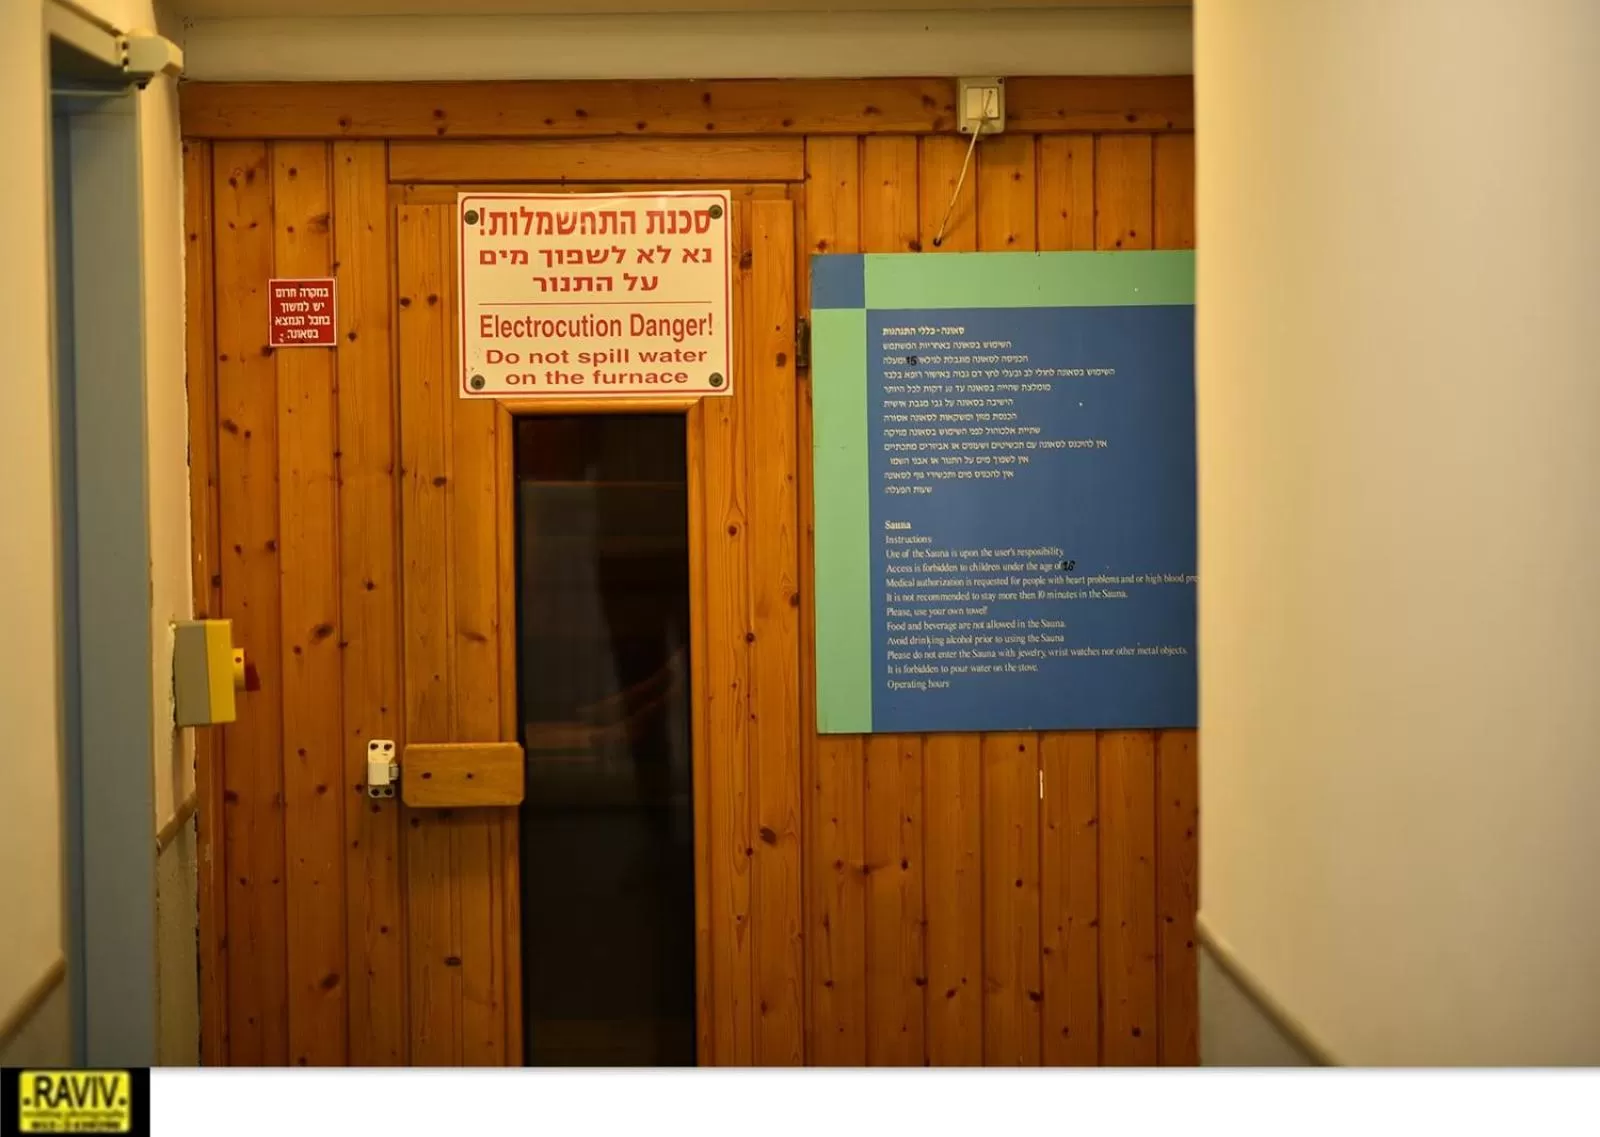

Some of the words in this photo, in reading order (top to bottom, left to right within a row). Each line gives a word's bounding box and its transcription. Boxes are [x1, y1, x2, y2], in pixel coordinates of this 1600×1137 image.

[479, 206, 635, 236] התחשמלות!
[647, 208, 711, 234] סכנת
[480, 249, 528, 265] מים
[539, 245, 626, 267] לשפוך
[637, 245, 671, 264] לא
[682, 248, 712, 263] נא
[533, 275, 613, 292] התנור
[624, 273, 658, 291] על
[275, 287, 296, 298] חרום
[300, 287, 329, 298] במקרה
[280, 301, 309, 313] למשוך
[312, 302, 325, 312] יש
[275, 315, 304, 326] הנמצא
[307, 315, 330, 326] בחבל
[480, 314, 622, 339] Electrocution
[630, 313, 713, 342] Danger!
[486, 350, 520, 364] Do
[529, 350, 569, 364] not
[578, 348, 629, 367] spill
[638, 348, 707, 363] water
[505, 372, 536, 385] on
[545, 370, 584, 385] the
[592, 369, 688, 385] furnace
[885, 521, 912, 529] Sauna
[885, 535, 932, 544] Instructions
[912, 548, 925, 558] the
[925, 548, 950, 558] Sauna
[959, 549, 979, 560] upon
[980, 547, 993, 557] the
[886, 564, 912, 573] Access
[922, 563, 958, 573] forbidden
[960, 563, 968, 572] to
[969, 562, 1000, 572] children
[1002, 562, 1025, 571] under
[1026, 561, 1038, 571] the
[1039, 563, 1053, 574] age
[1054, 561, 1062, 571] of
[886, 578, 915, 587] Medical
[916, 577, 964, 587] authorization
[974, 576, 1009, 589] requested
[1010, 576, 1021, 585] for
[1022, 575, 1046, 588] people
[1047, 575, 1064, 585] with
[1065, 575, 1086, 584] heart
[1087, 574, 1120, 587] problems
[1120, 574, 1135, 583] and
[1145, 573, 1163, 586] high
[1164, 573, 1185, 583] blood
[894, 593, 901, 602] is
[902, 593, 915, 602] not
[916, 592, 970, 602] recommended
[971, 591, 980, 601] to
[981, 591, 996, 604] stay
[1047, 590, 1078, 600] minutes
[1080, 589, 1087, 599] in
[1089, 589, 1102, 599] the
[914, 608, 927, 616] use
[928, 608, 946, 619] your
[886, 621, 906, 630] Food
[907, 620, 922, 630] and
[923, 620, 958, 632] beverage
[971, 619, 985, 629] not
[985, 619, 1016, 629] allowed
[1017, 619, 1026, 628] in
[1027, 618, 1040, 628] the
[886, 636, 908, 645] Avoid
[909, 635, 945, 648] drinking
[946, 635, 973, 644] alcohol
[974, 634, 993, 647] prior
[995, 634, 1004, 644] to
[1004, 634, 1026, 646] using
[1027, 633, 1040, 643] the
[887, 650, 911, 659] Please
[912, 649, 922, 659] do
[923, 649, 937, 659] not
[938, 649, 957, 659] enter
[959, 649, 971, 658] the
[971, 648, 997, 658] Sauna
[998, 648, 1016, 657] with
[1047, 647, 1069, 657] wrist
[1070, 646, 1100, 656] watches
[1115, 646, 1136, 655] other
[1137, 645, 1159, 655] metal
[895, 665, 902, 674] is
[903, 664, 939, 674] forbidden
[940, 664, 949, 674] to
[949, 666, 968, 676] pour
[969, 663, 992, 673] water
[992, 665, 1003, 673] on
[1003, 663, 1017, 672] the
[886, 680, 927, 692] Operating
